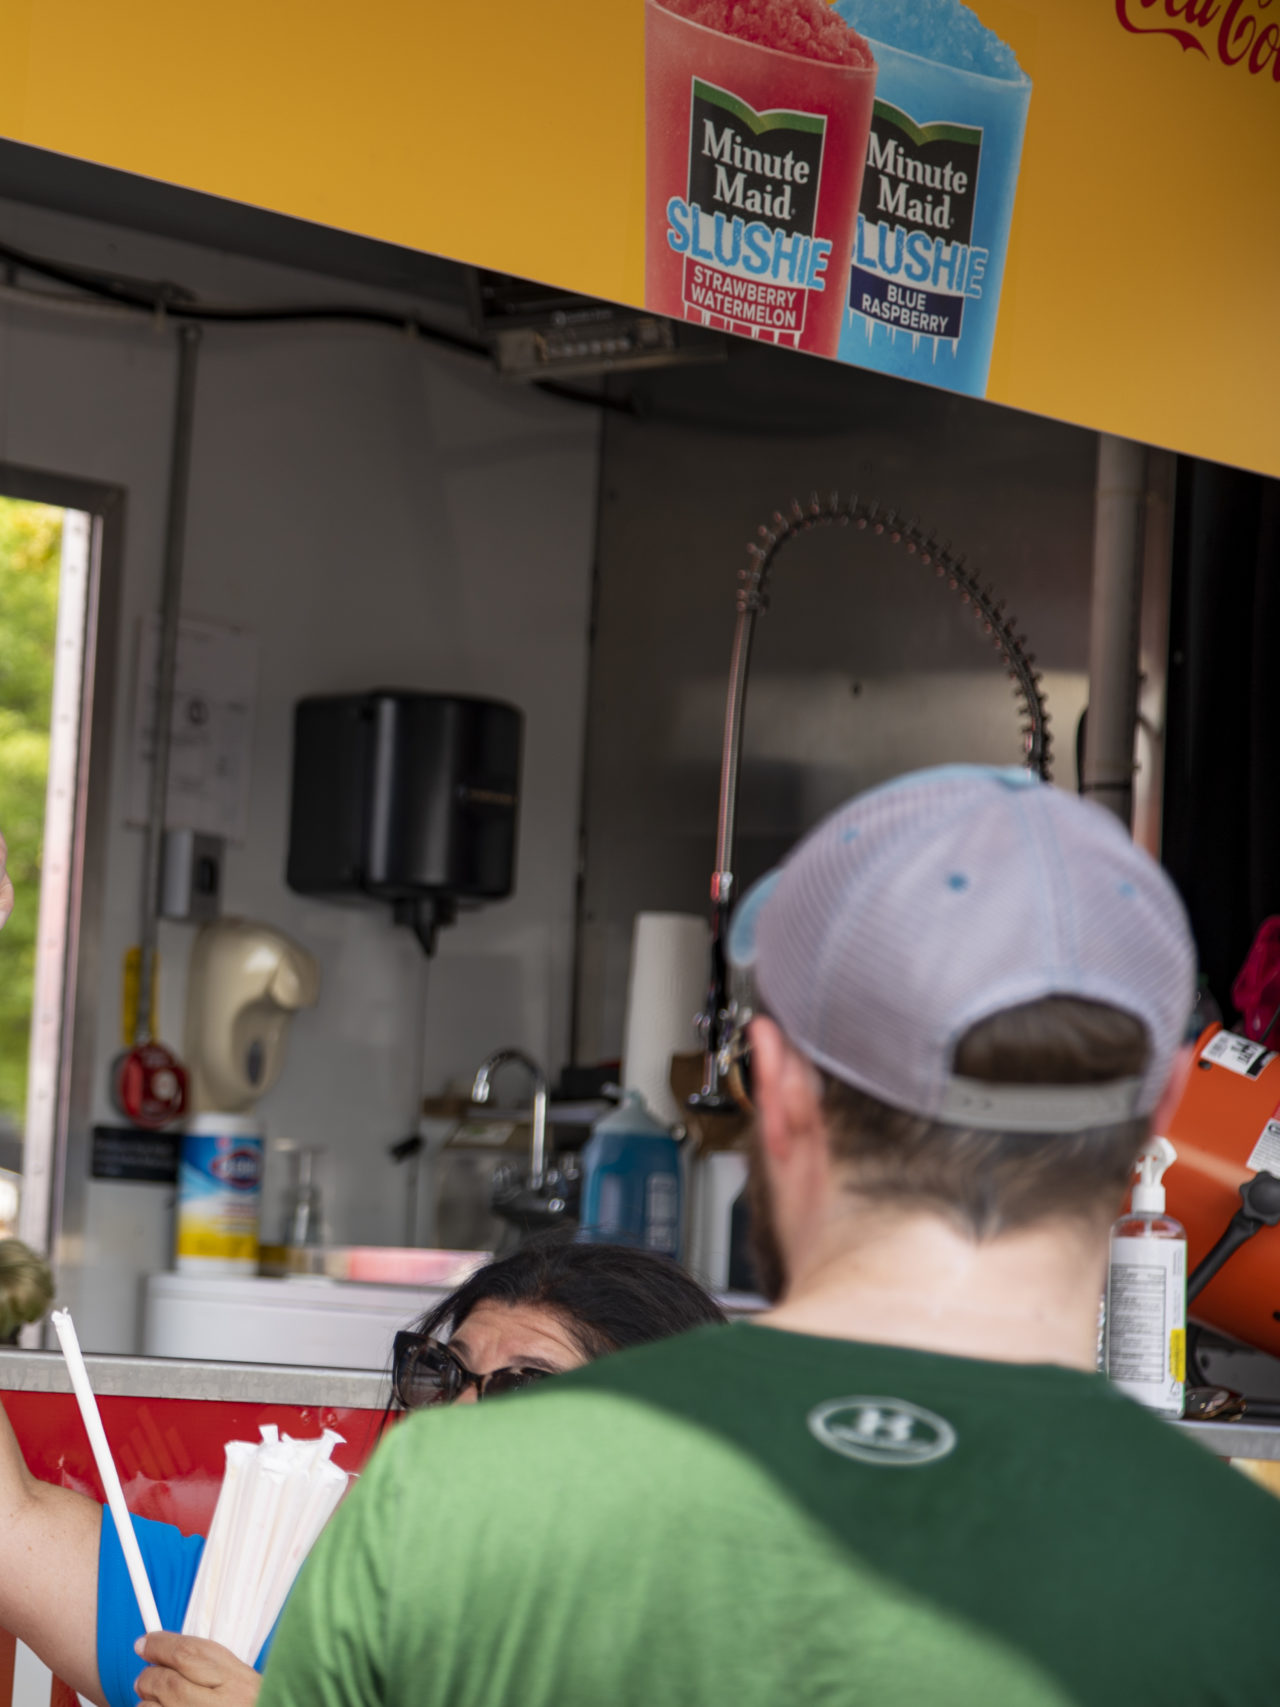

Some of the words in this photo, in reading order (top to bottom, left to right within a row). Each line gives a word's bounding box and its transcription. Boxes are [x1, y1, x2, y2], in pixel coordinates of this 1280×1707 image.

[701, 117, 811, 184] Minute
[866, 131, 968, 194] Minute
[712, 163, 793, 220] Maid
[876, 174, 951, 230] Maid
[667, 196, 833, 291] SLUSHIE
[851, 213, 989, 299] LUSHIE
[691, 282, 797, 328] WATERMELON
[694, 265, 797, 308] STRAWBERRY
[862, 293, 949, 334] RASPBERRY
[887, 284, 927, 311] BLUE
